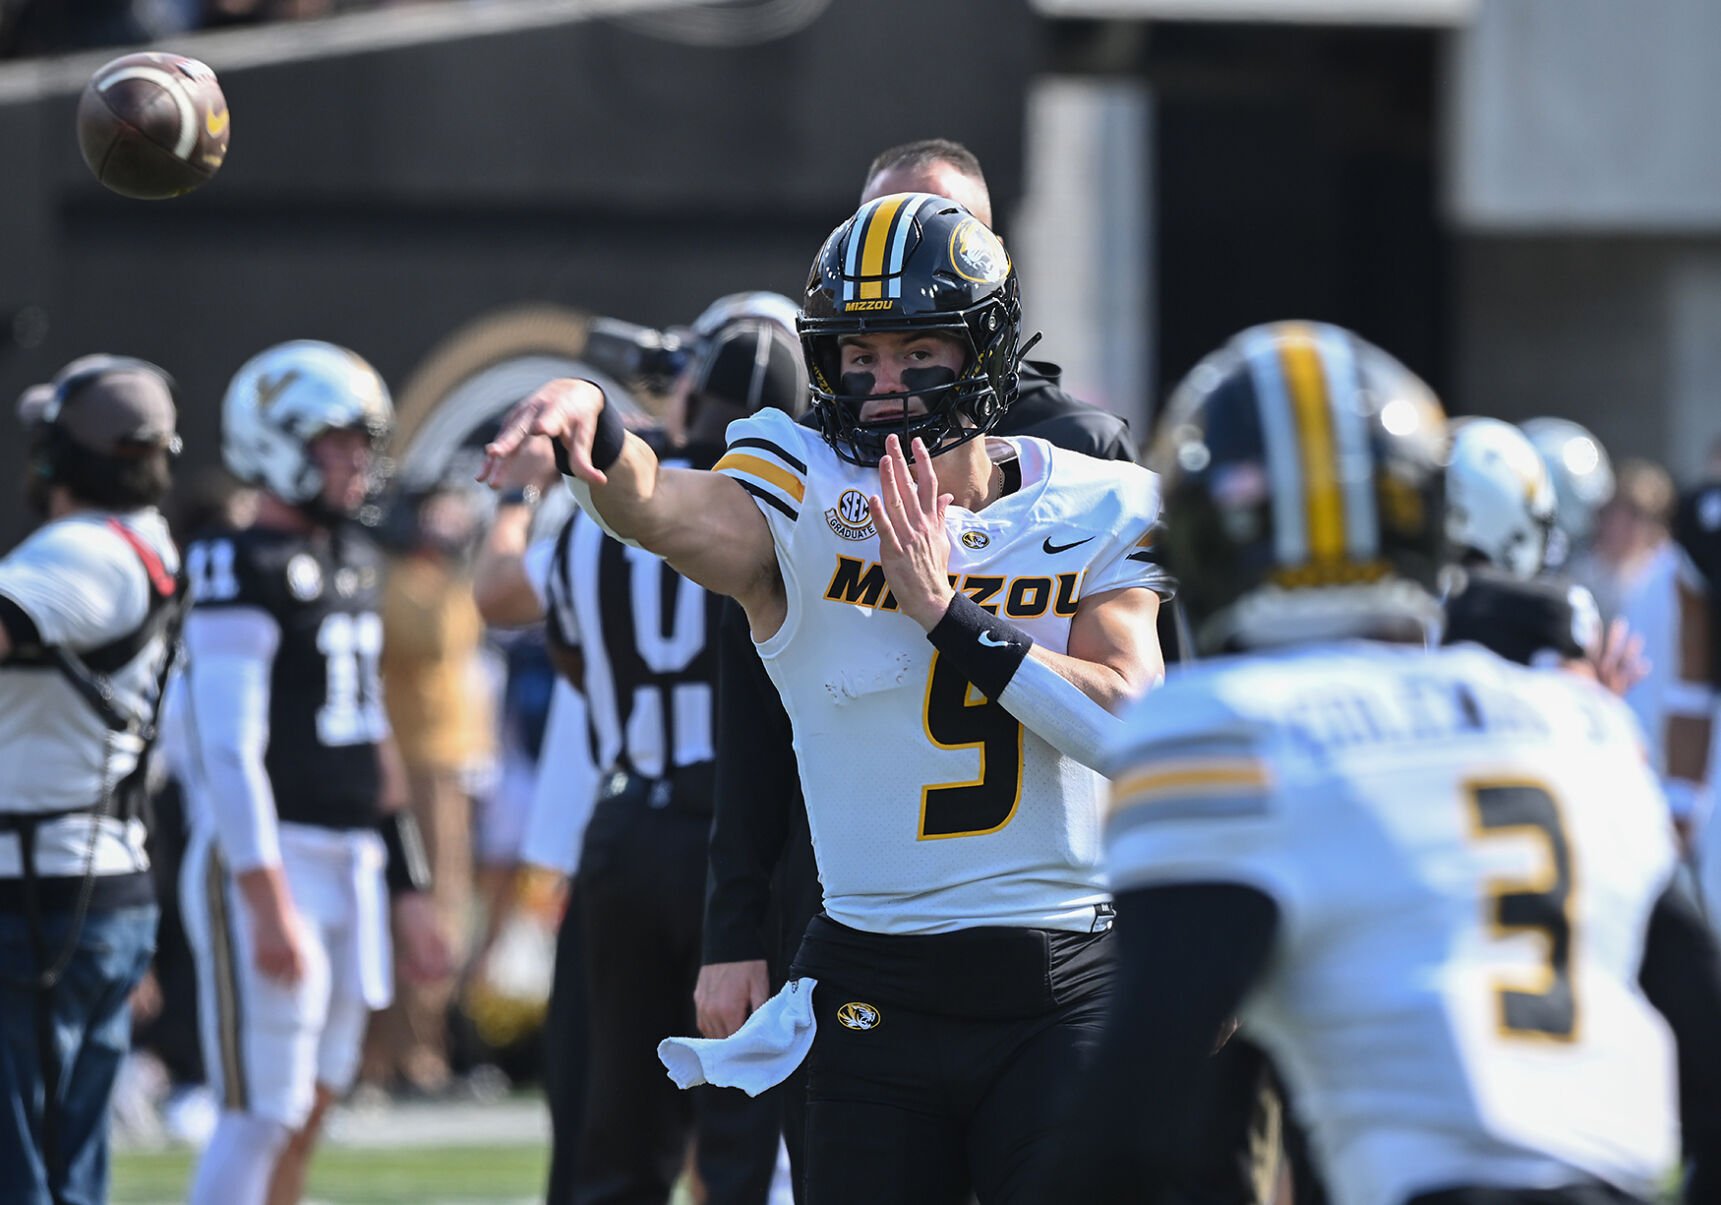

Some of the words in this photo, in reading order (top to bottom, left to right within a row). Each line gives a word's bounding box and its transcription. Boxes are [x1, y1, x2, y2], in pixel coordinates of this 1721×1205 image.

[845, 300, 893, 312] MIZZOU
[829, 518, 875, 539] GRADUATE
[839, 490, 870, 522] SEC
[823, 553, 1089, 619] MZOU
[316, 612, 391, 746] 11
[917, 649, 1024, 840] 9
[1459, 774, 1580, 1043] 3
